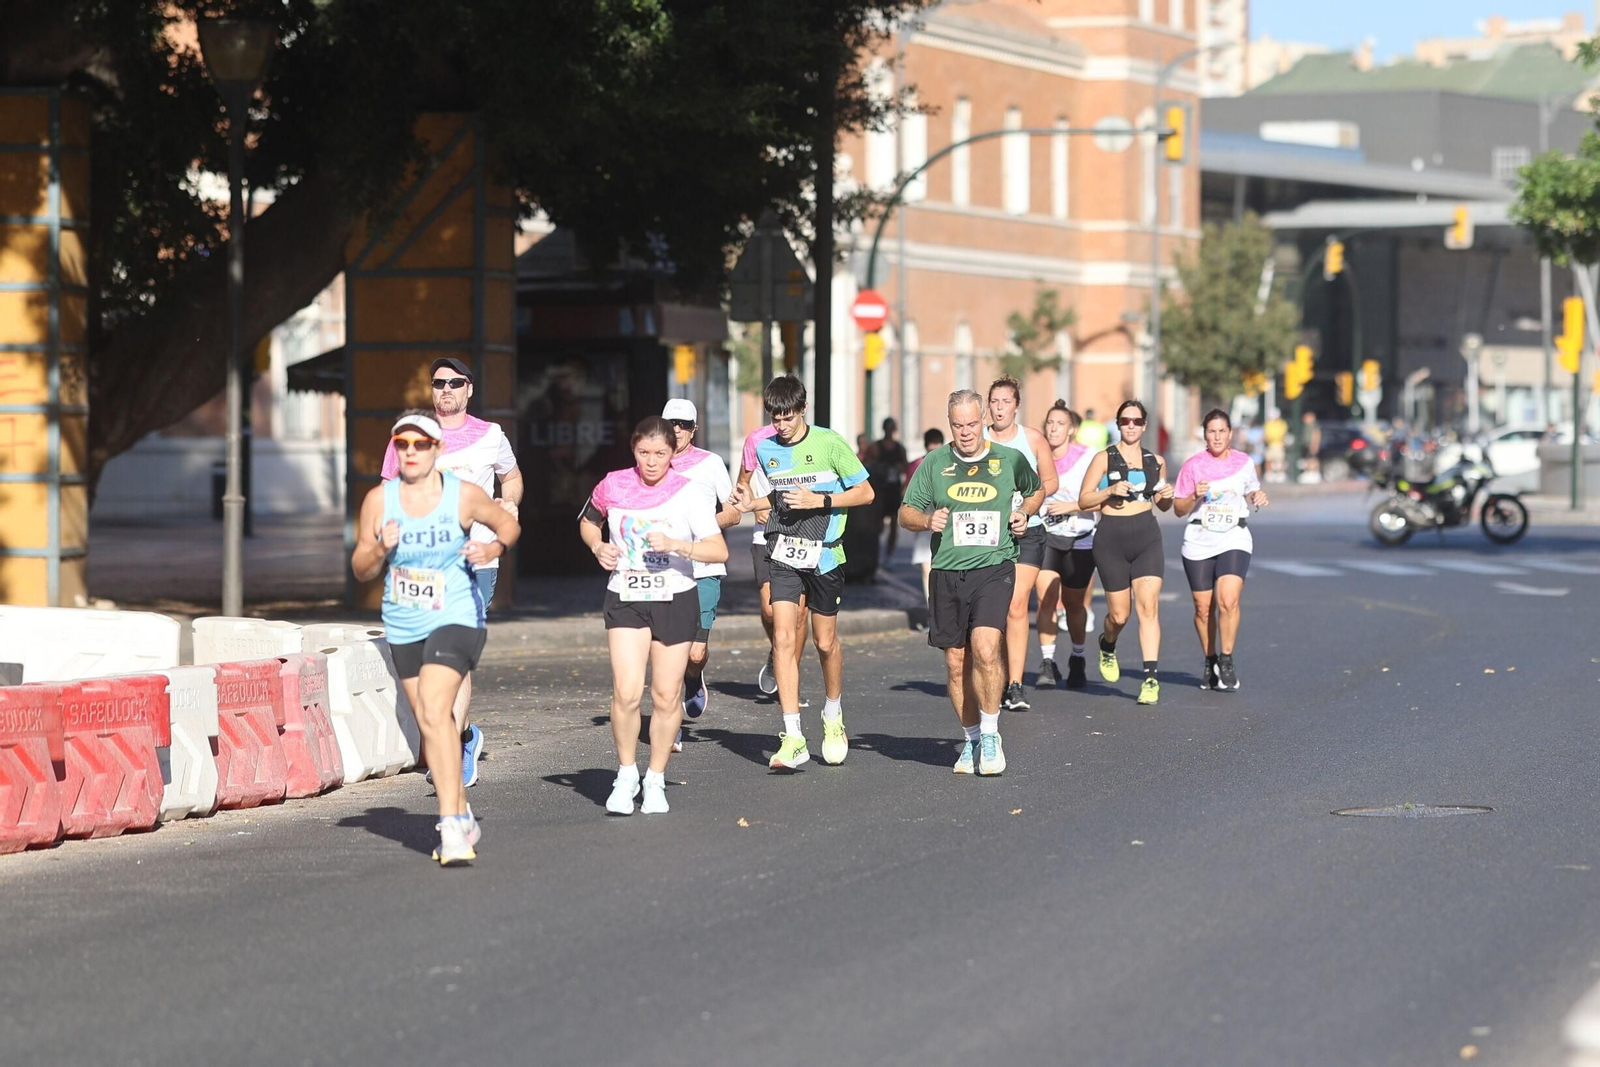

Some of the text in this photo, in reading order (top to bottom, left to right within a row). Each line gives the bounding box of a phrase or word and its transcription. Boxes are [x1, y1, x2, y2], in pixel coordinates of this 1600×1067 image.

[530, 419, 616, 446] LIBRE
[956, 486, 988, 498] MTN
[1047, 514, 1072, 525] 327
[1207, 512, 1233, 524] 276
[965, 522, 988, 535] 38
[397, 525, 451, 548] erja
[785, 546, 808, 560] 39
[642, 556, 670, 568] 2025
[627, 574, 666, 589] 259
[399, 581, 434, 598] 194
[172, 687, 200, 710] LOCK
